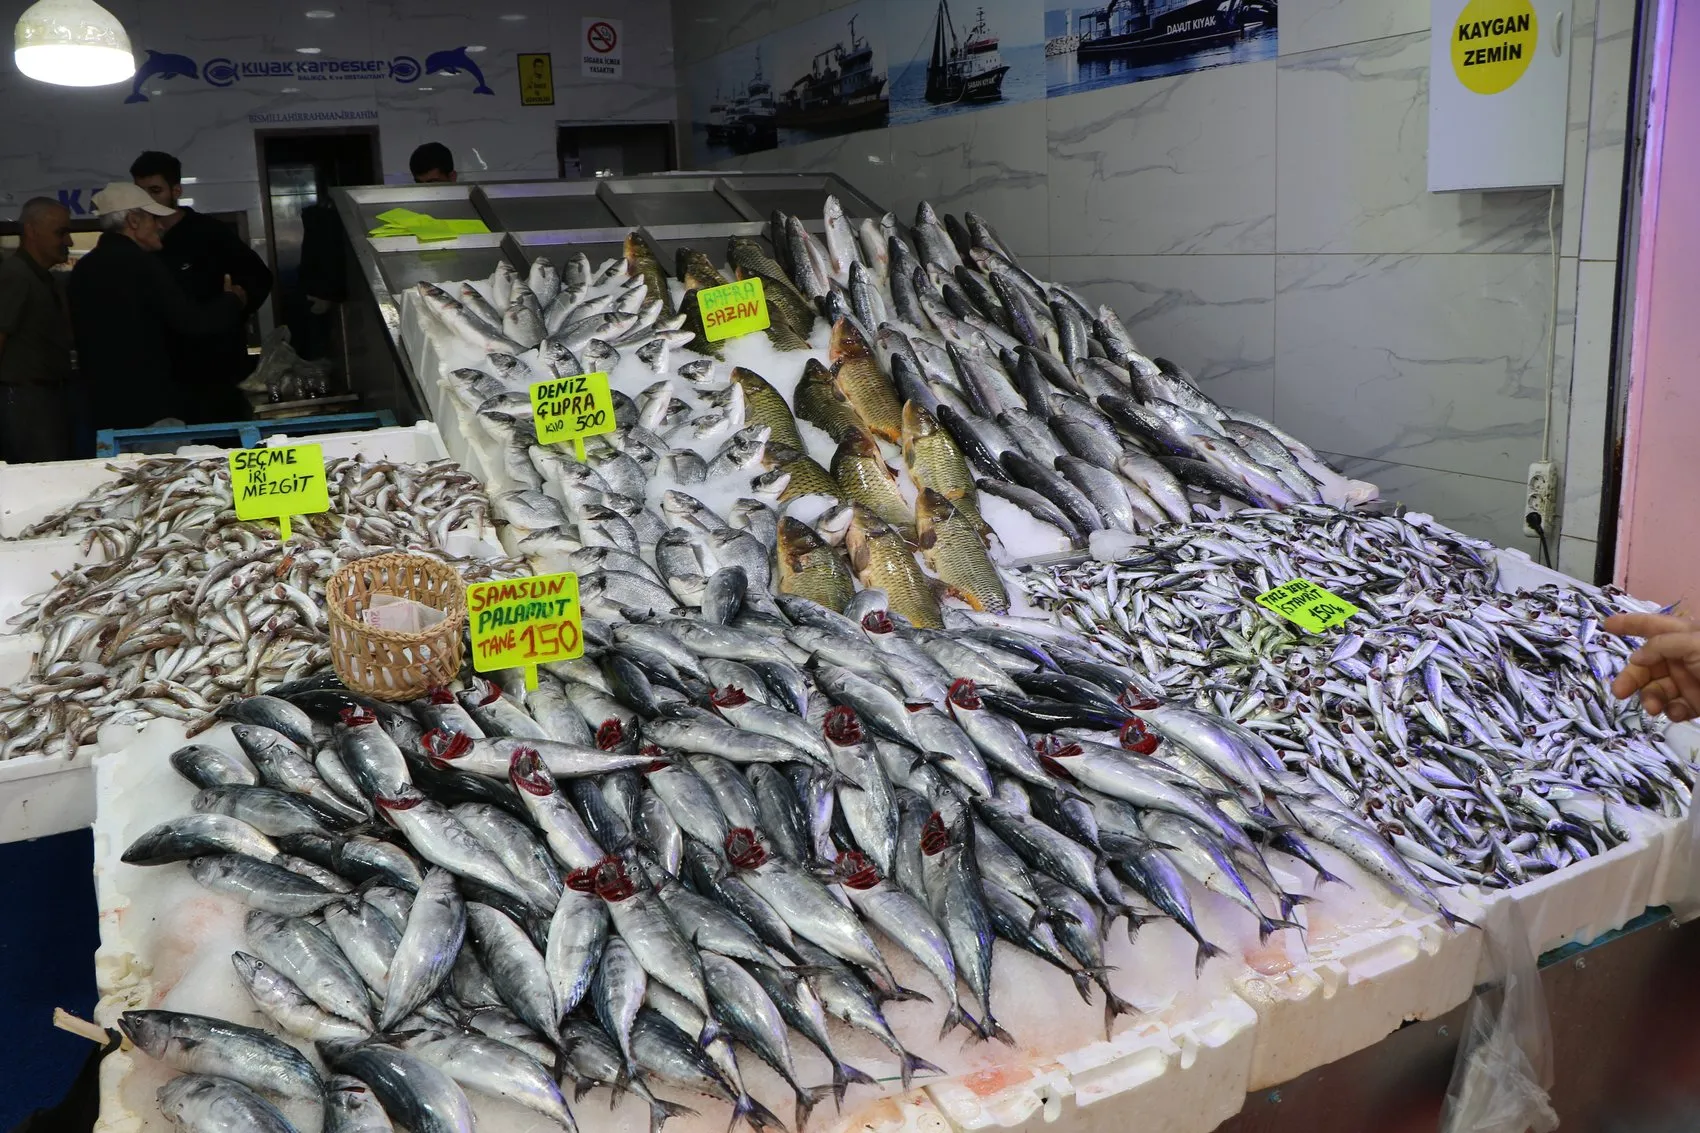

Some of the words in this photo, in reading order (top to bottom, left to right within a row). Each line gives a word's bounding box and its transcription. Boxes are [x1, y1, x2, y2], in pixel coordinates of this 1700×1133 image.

[1166, 21, 1191, 35] DAVUT
[1192, 15, 1217, 30] KIYAK
[1458, 13, 1530, 42] KAYGAN
[1463, 41, 1522, 67] ZEMİN
[706, 300, 759, 328] SAZAN
[537, 377, 588, 400] DENİZ
[537, 392, 596, 420] ÇUPRA
[575, 409, 606, 432] 500
[235, 448, 297, 470] SEÇME
[242, 473, 315, 501] MEZGİT
[248, 467, 266, 484] İRİ
[471, 576, 566, 612] SAMSUN
[1261, 589, 1288, 606] TAZE
[478, 598, 571, 634] PALAMUT
[477, 628, 516, 659] TANE
[519, 619, 579, 659] 150
